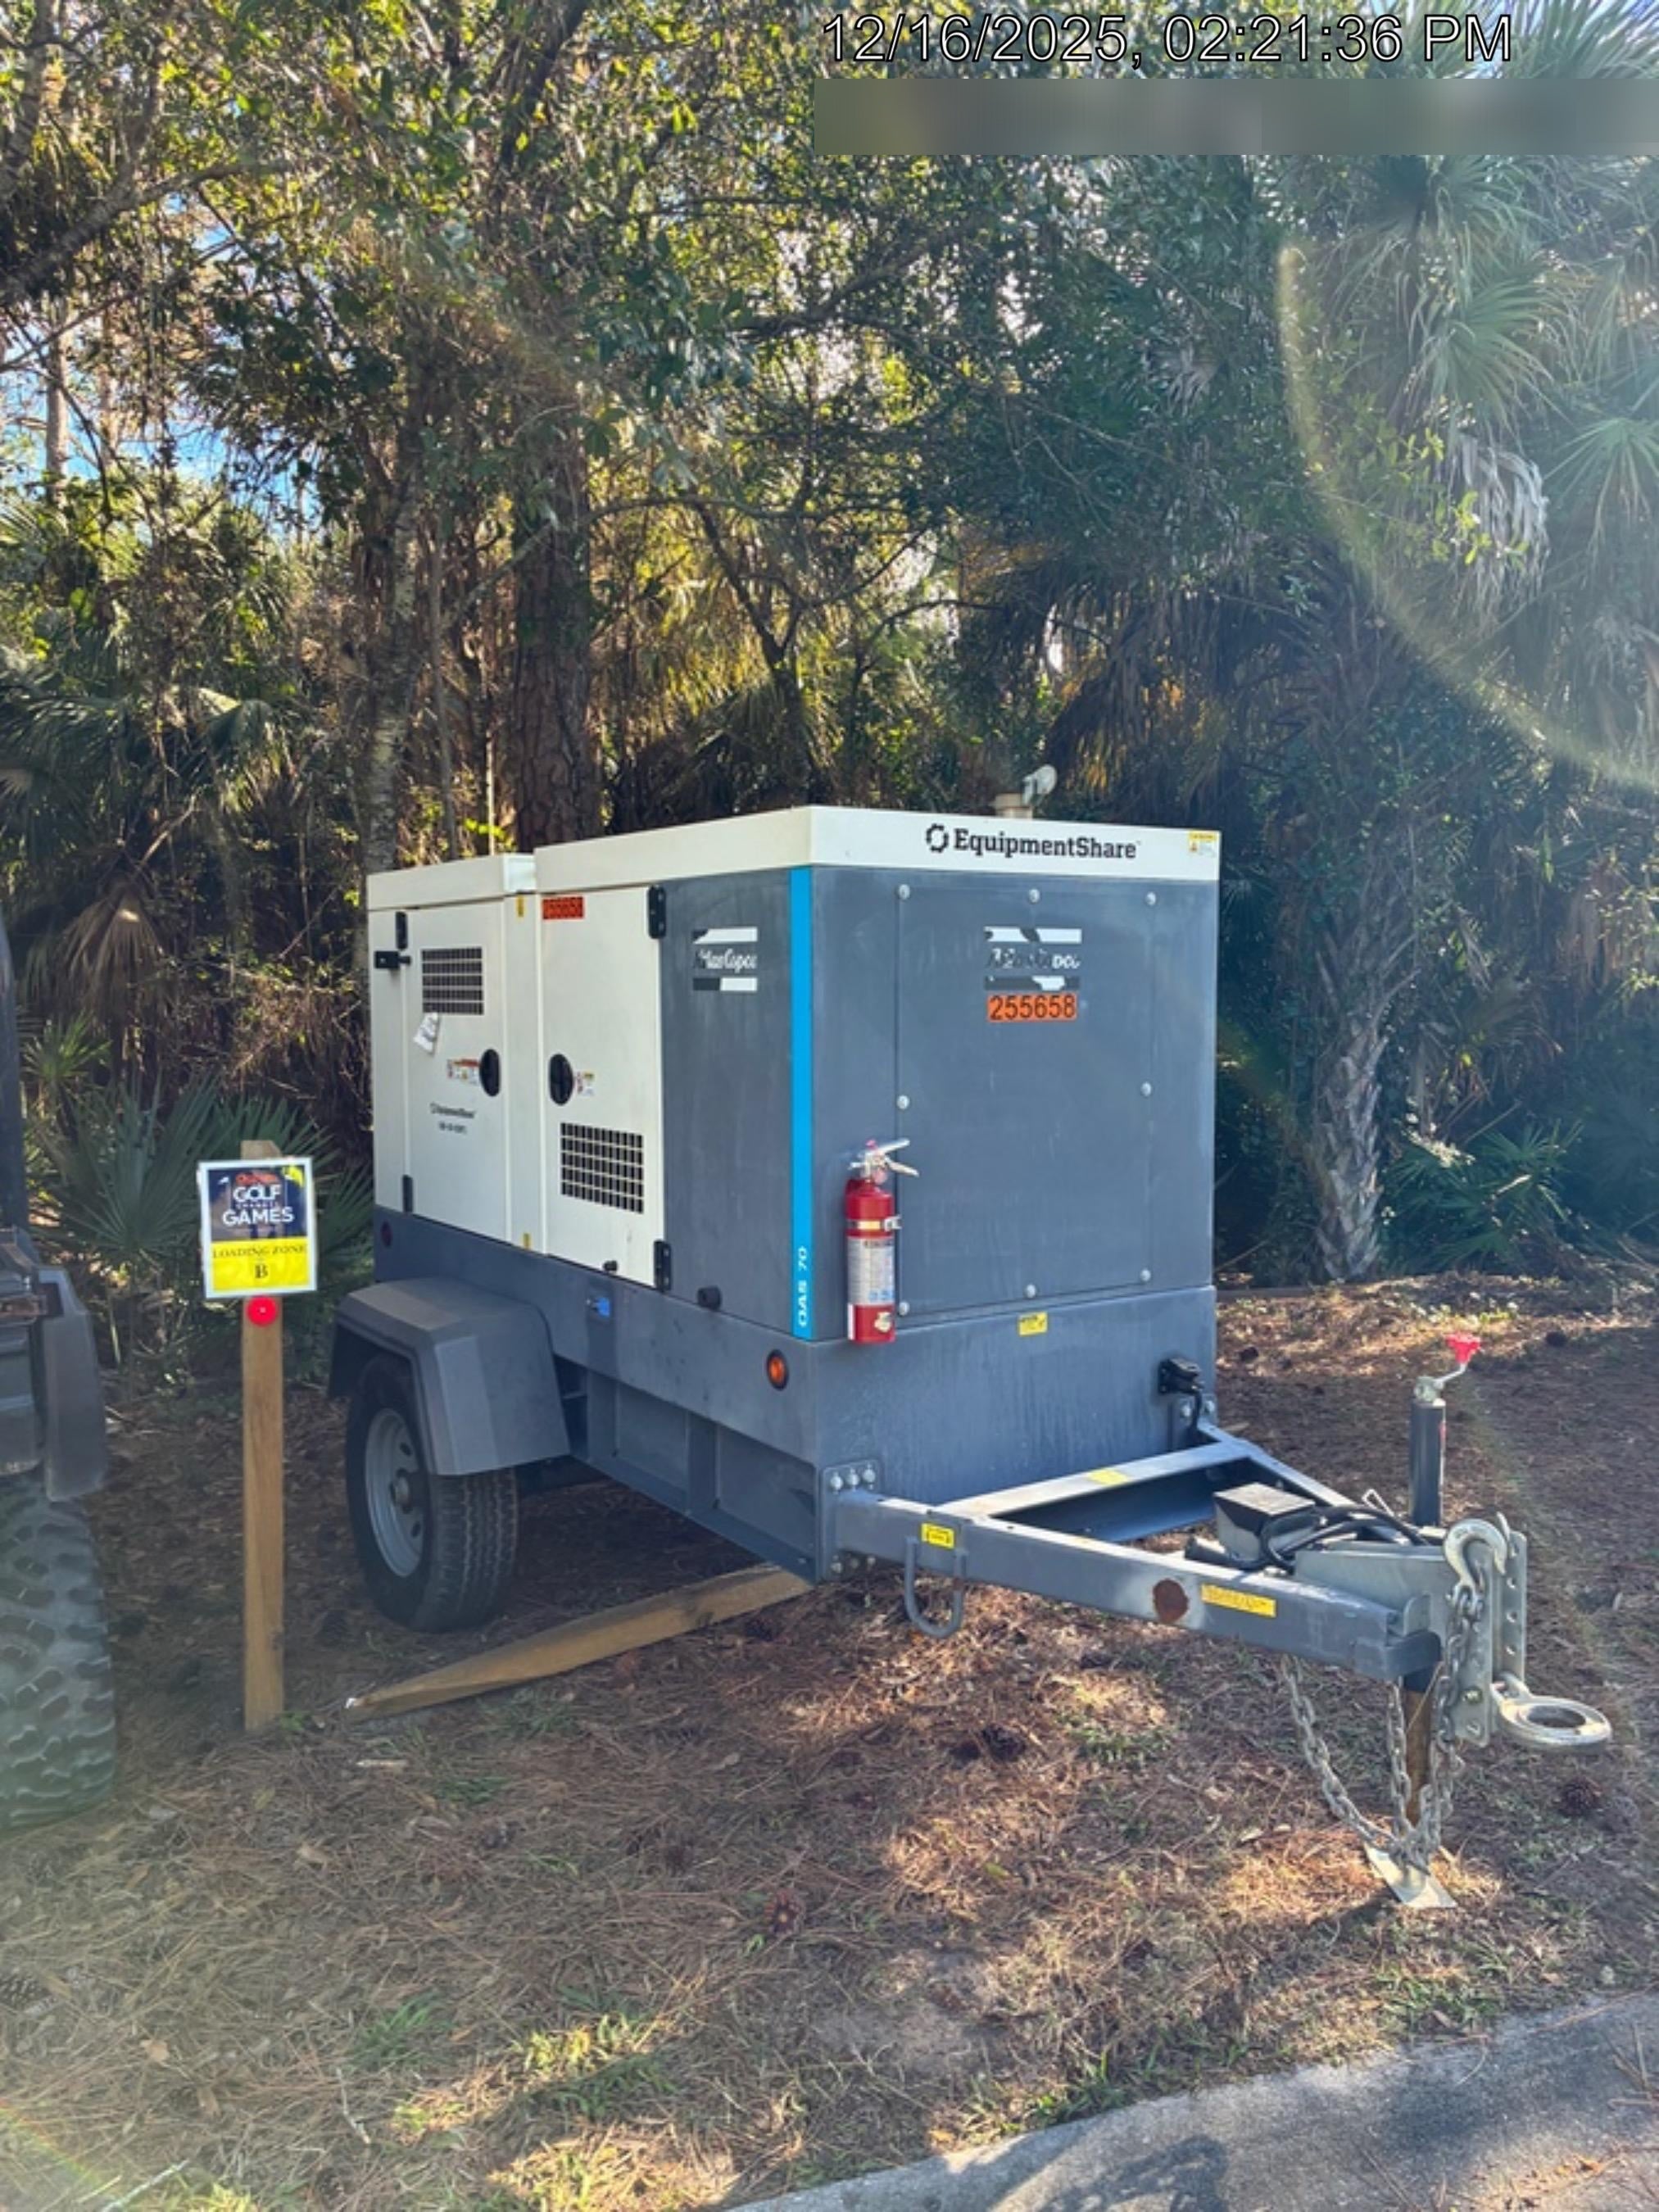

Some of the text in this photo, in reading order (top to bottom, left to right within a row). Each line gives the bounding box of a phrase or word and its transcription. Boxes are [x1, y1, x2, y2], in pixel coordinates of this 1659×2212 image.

[954, 827, 1137, 859] EquipmentShare
[989, 995, 1075, 1021] 255658
[233, 1184, 281, 1203] GOLF
[222, 1206, 295, 1226] GAMES
[212, 1244, 306, 1259] LOADING ZONE
[798, 1245, 808, 1271] 70
[255, 1264, 269, 1279] B
